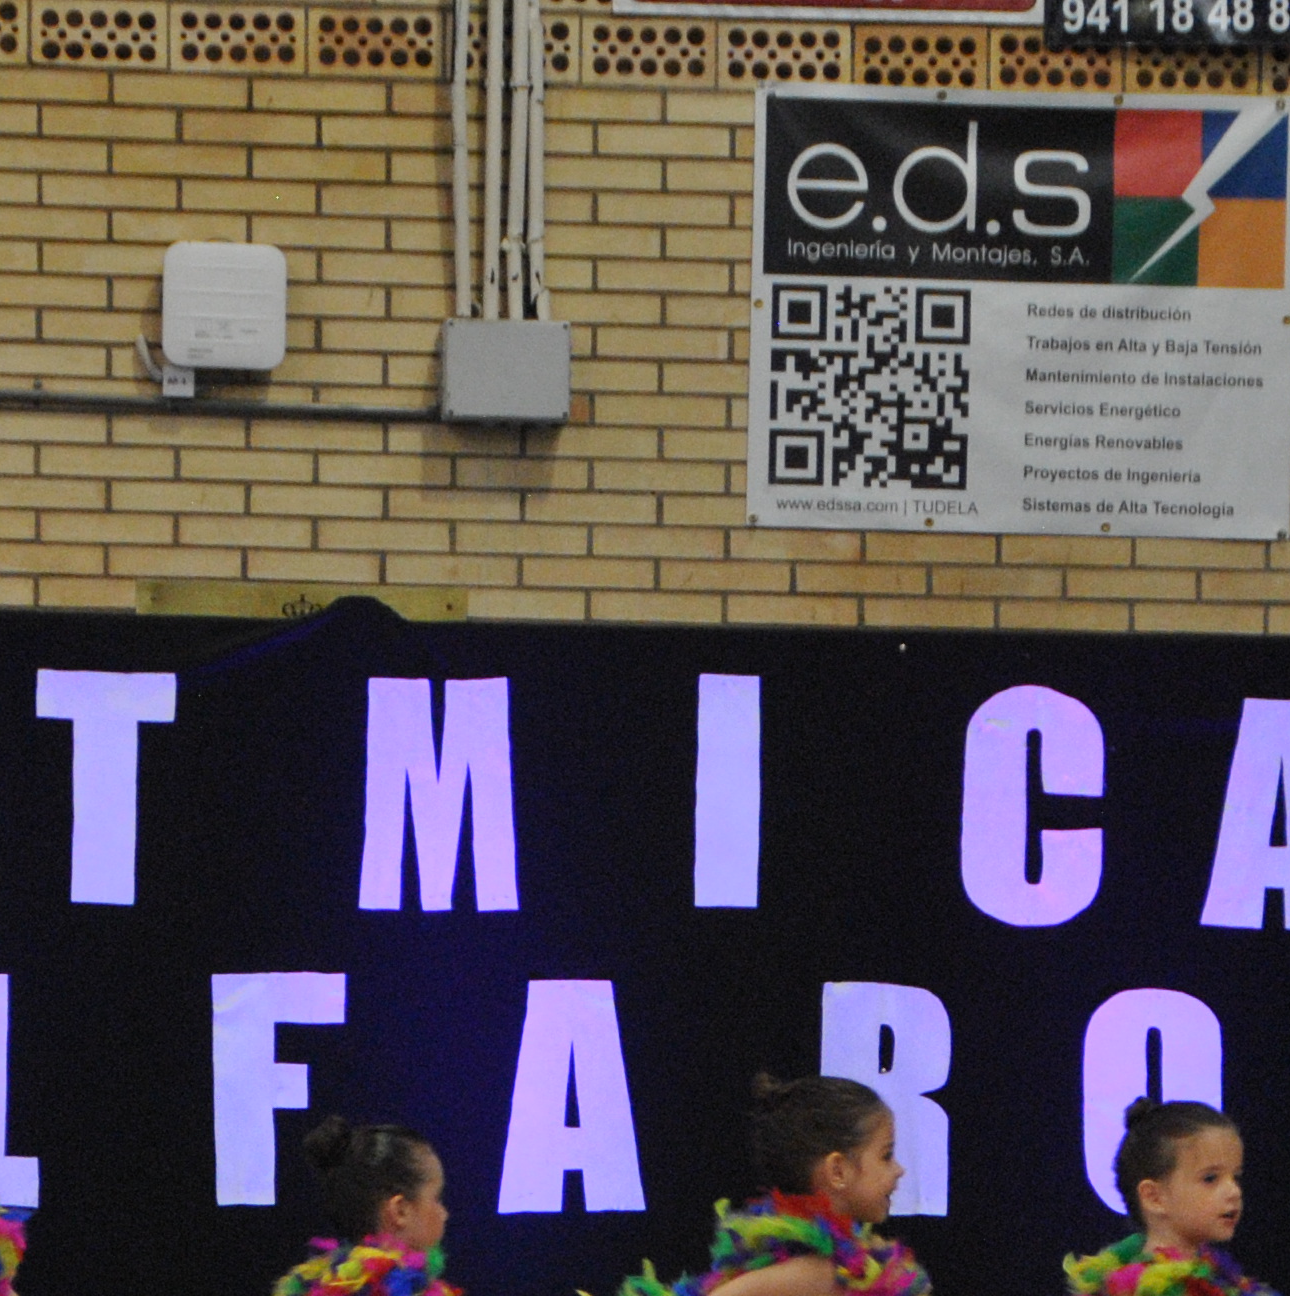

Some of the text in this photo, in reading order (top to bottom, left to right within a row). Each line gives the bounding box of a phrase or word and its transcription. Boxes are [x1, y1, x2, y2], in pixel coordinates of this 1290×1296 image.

[1062, 0, 1129, 33] 941
[1149, 0, 1194, 33] 18
[1208, 0, 1255, 33] 48
[787, 121, 1092, 236] e.d.s
[908, 244, 920, 264] y
[1050, 245, 1091, 266] S.A.
[1027, 303, 1074, 319] Redes
[1079, 304, 1098, 320] de
[1027, 335, 1091, 355] Trabajos
[1095, 340, 1114, 353] en
[1118, 337, 1147, 353] Alta
[1151, 342, 1160, 357] y
[1165, 338, 1198, 358] Baja
[1025, 367, 1264, 389] Mantenimiento de Instalaciones
[1025, 400, 1094, 417] Servicios
[1095, 434, 1184, 451] Renovables
[1023, 464, 1100, 484] Proyectos
[1104, 467, 1123, 482] de
[776, 498, 979, 516] www.edssa.com TUDELA
[1022, 497, 1092, 514] Sistemas
[1096, 499, 1114, 514] de
[1118, 500, 1148, 515] Alta
